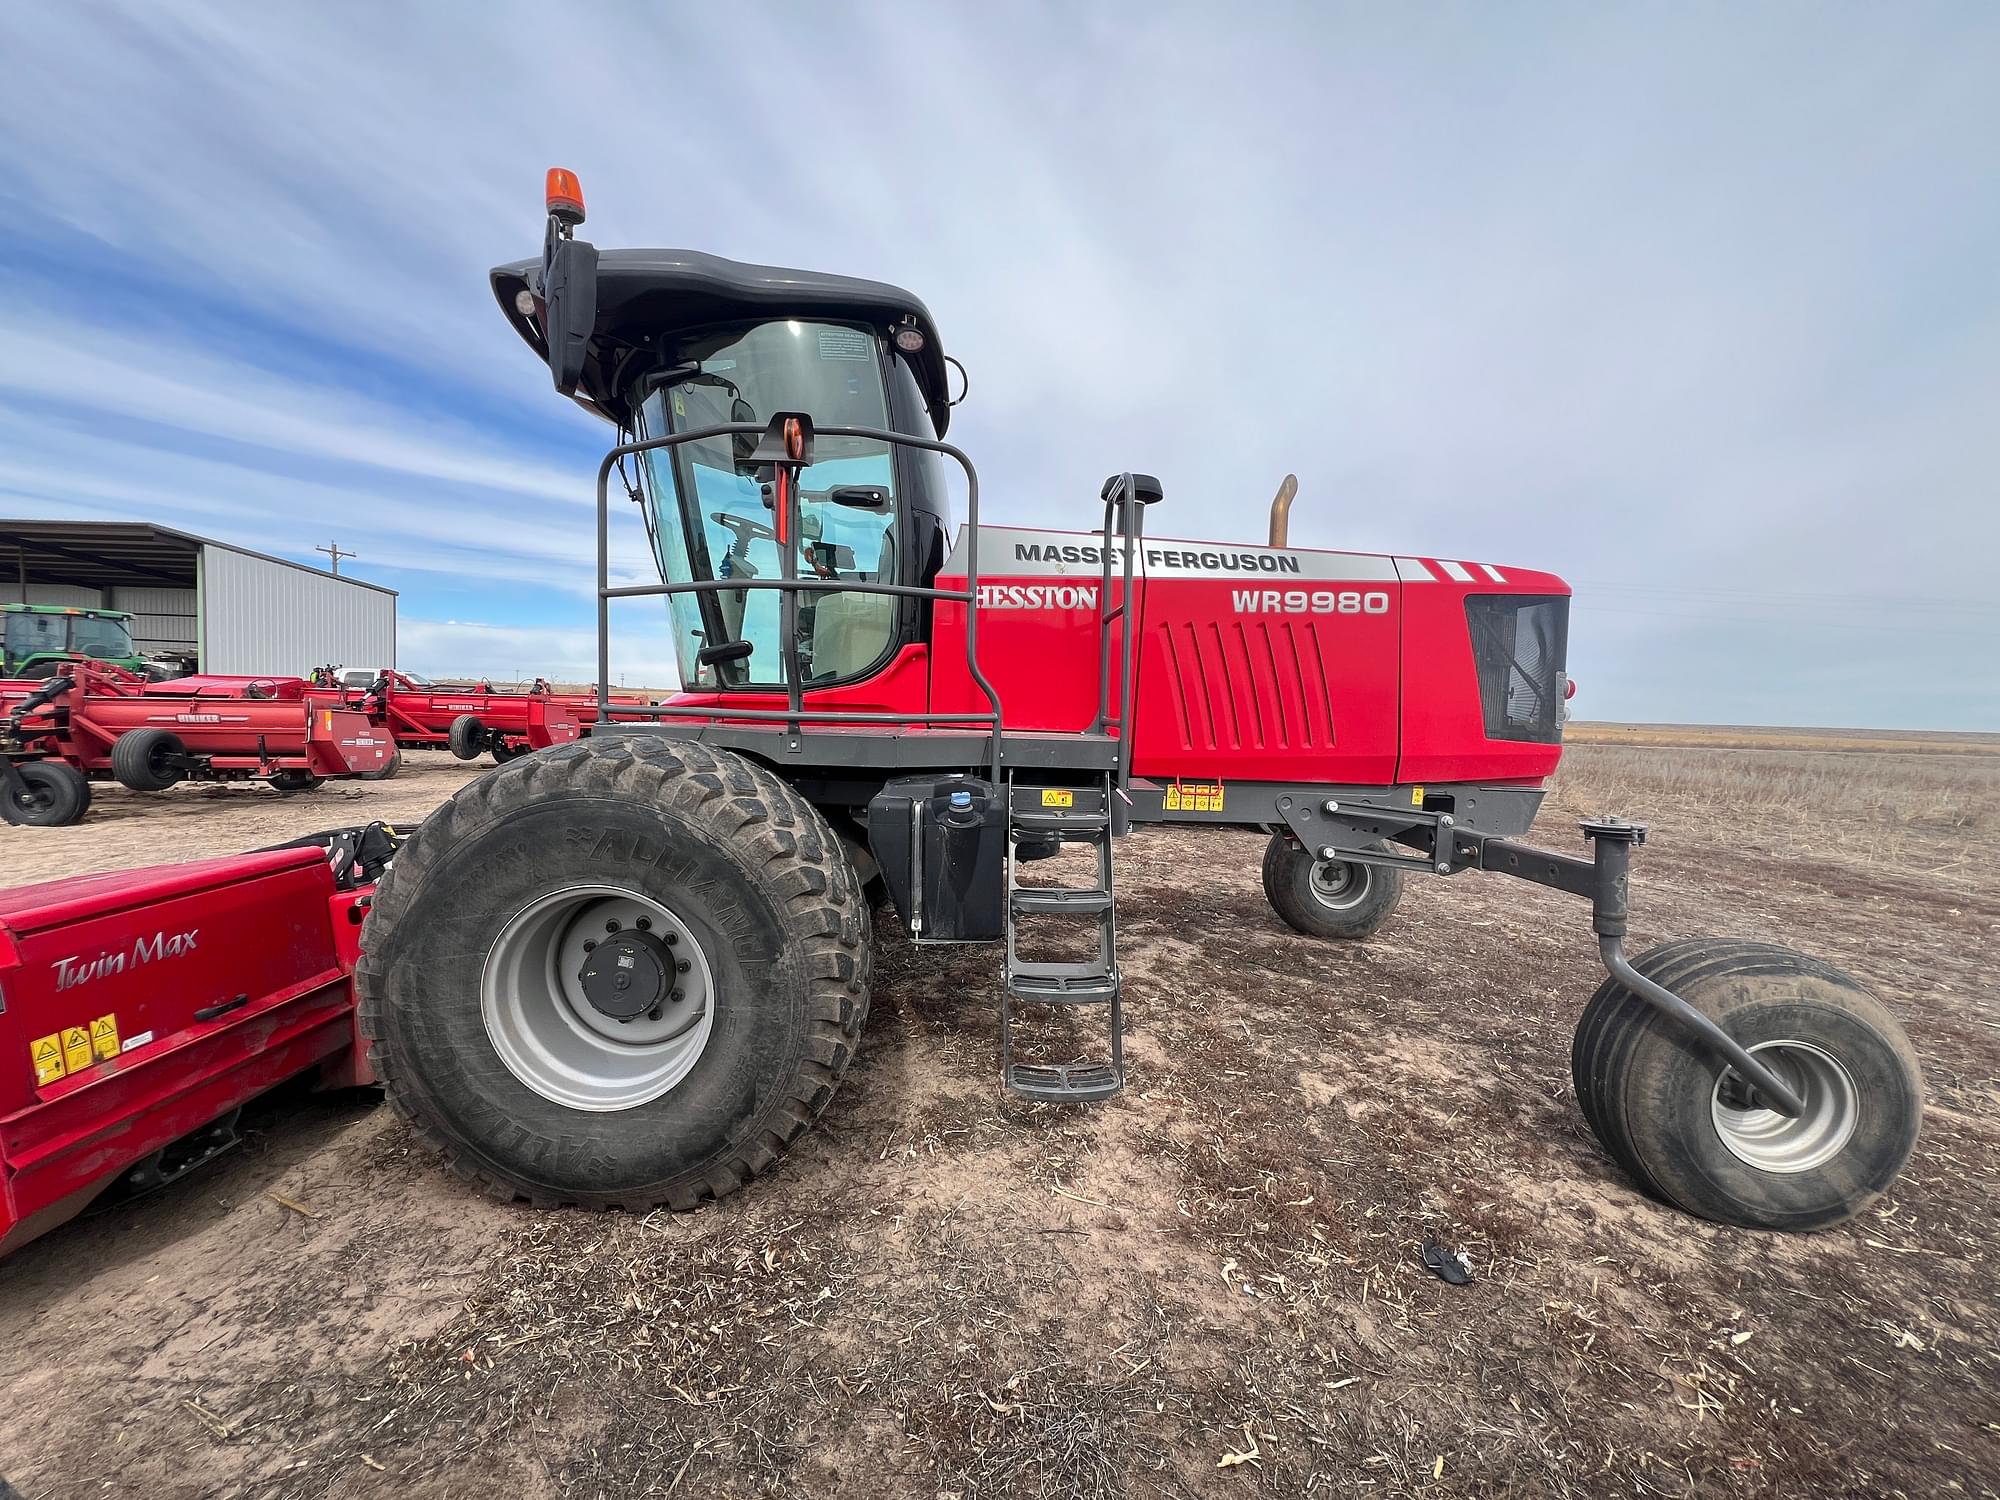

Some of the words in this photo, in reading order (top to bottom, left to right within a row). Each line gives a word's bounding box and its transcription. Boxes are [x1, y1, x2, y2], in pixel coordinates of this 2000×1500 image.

[1015, 544, 1136, 565] MASSEY
[1147, 550, 1300, 573] FERGUSON
[976, 585, 1098, 609] HESSTON
[1232, 590, 1389, 614] WR9980
[51, 951, 125, 992] Twin
[130, 929, 198, 969] Max
